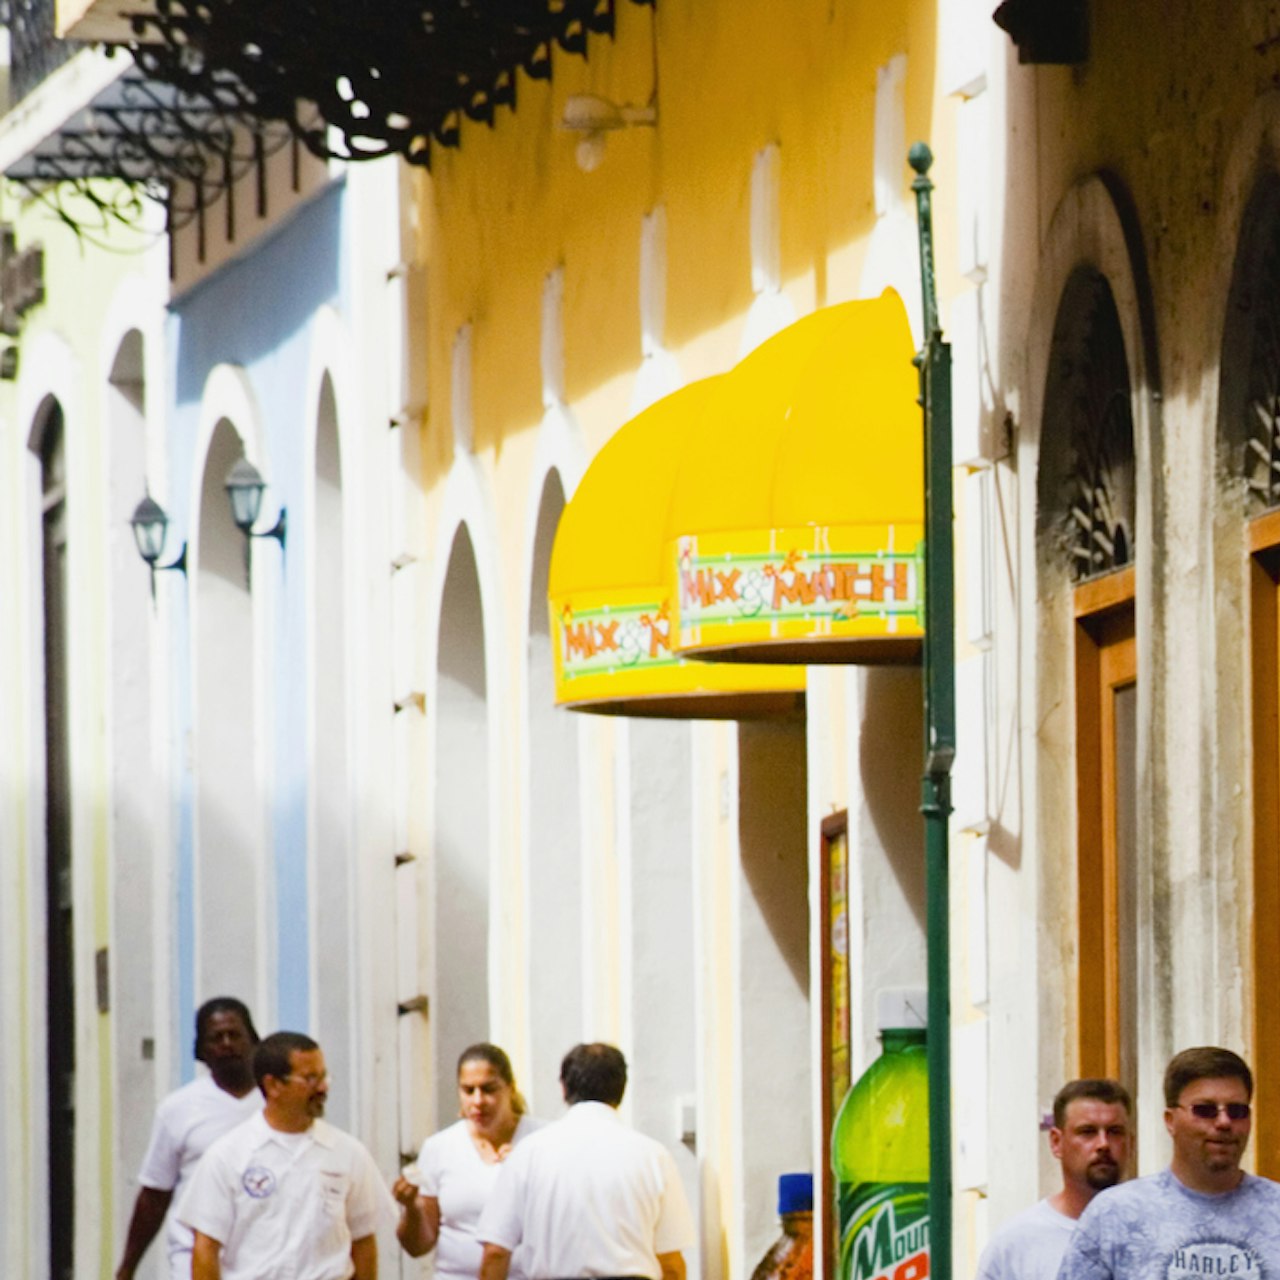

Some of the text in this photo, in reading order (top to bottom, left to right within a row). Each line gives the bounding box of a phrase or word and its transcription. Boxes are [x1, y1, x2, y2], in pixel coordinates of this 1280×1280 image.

[681, 562, 908, 617] MIX & MATCH
[564, 618, 620, 662] MIX
[1174, 1249, 1255, 1275] HARLEY
